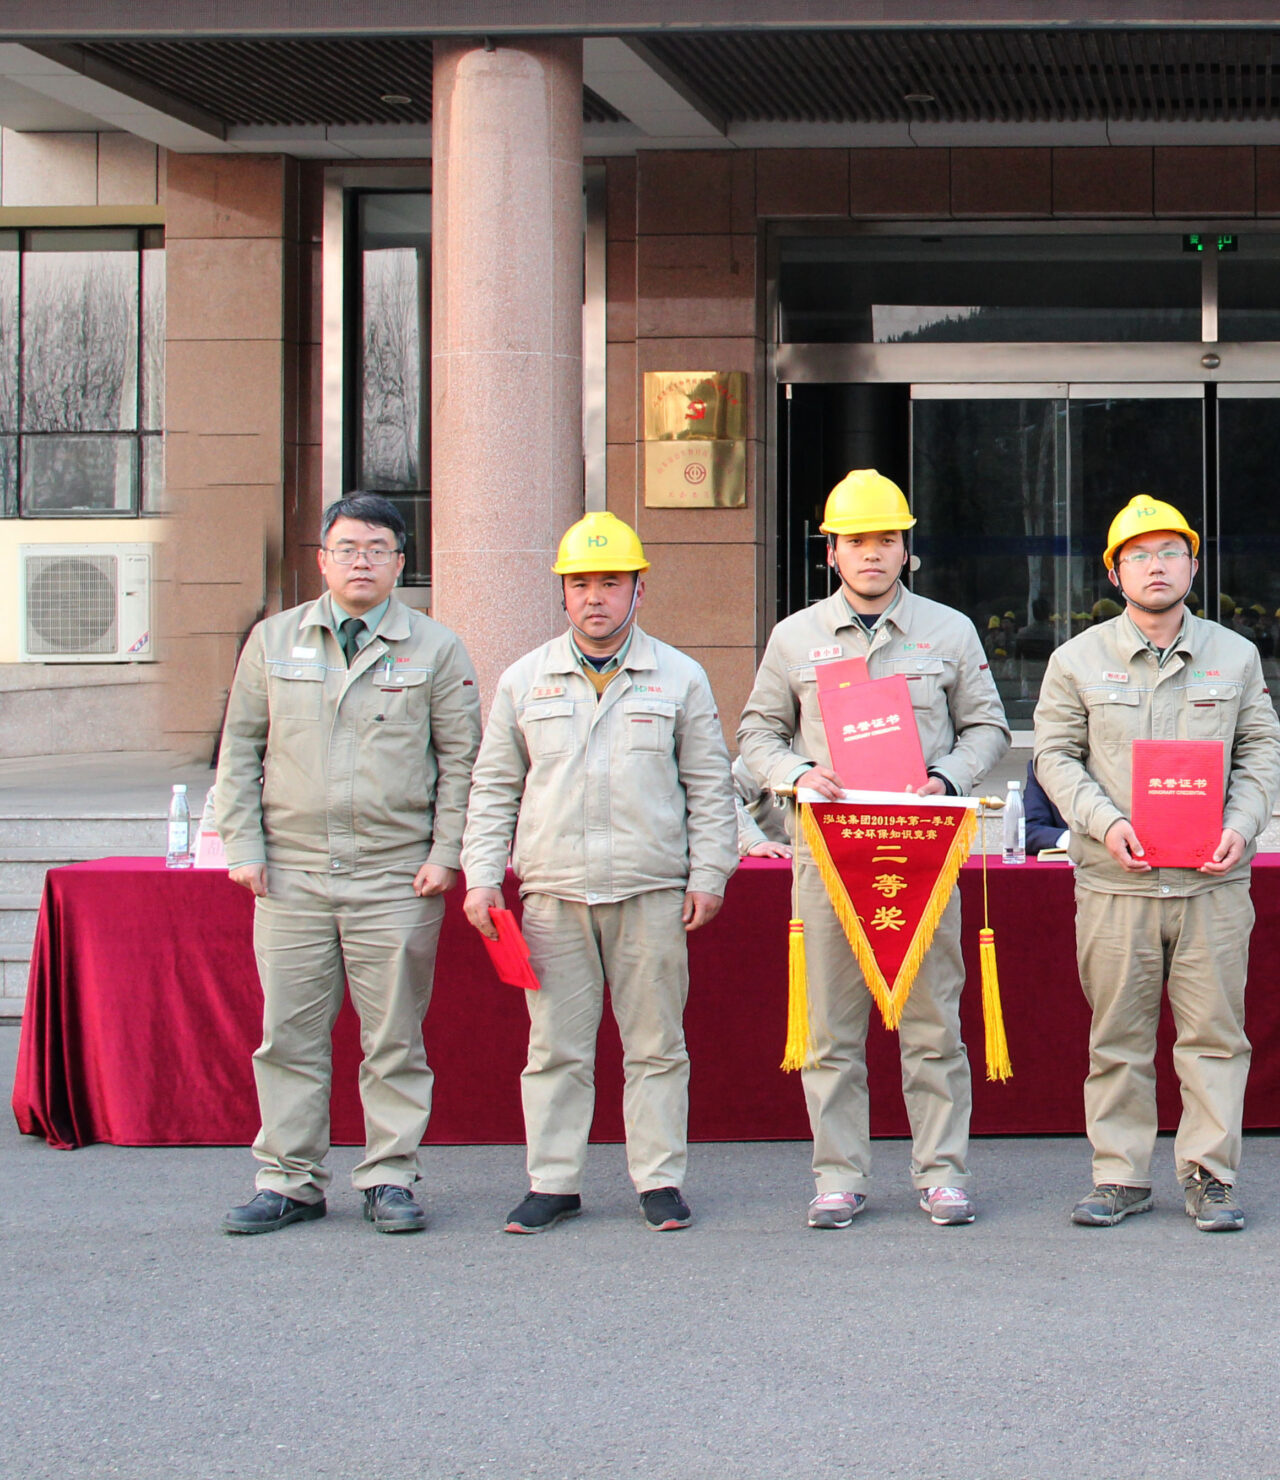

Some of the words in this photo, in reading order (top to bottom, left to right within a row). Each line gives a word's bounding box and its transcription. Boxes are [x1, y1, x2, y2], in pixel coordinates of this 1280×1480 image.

[587, 535, 608, 548] HD
[842, 713, 900, 735] 荣誉证书
[1148, 777, 1208, 789] 荣誉证书
[822, 814, 956, 827] 泓达集团2019年第一季度
[840, 828, 938, 840] 安全环保知识竞赛
[870, 844, 908, 931] 二等奖
